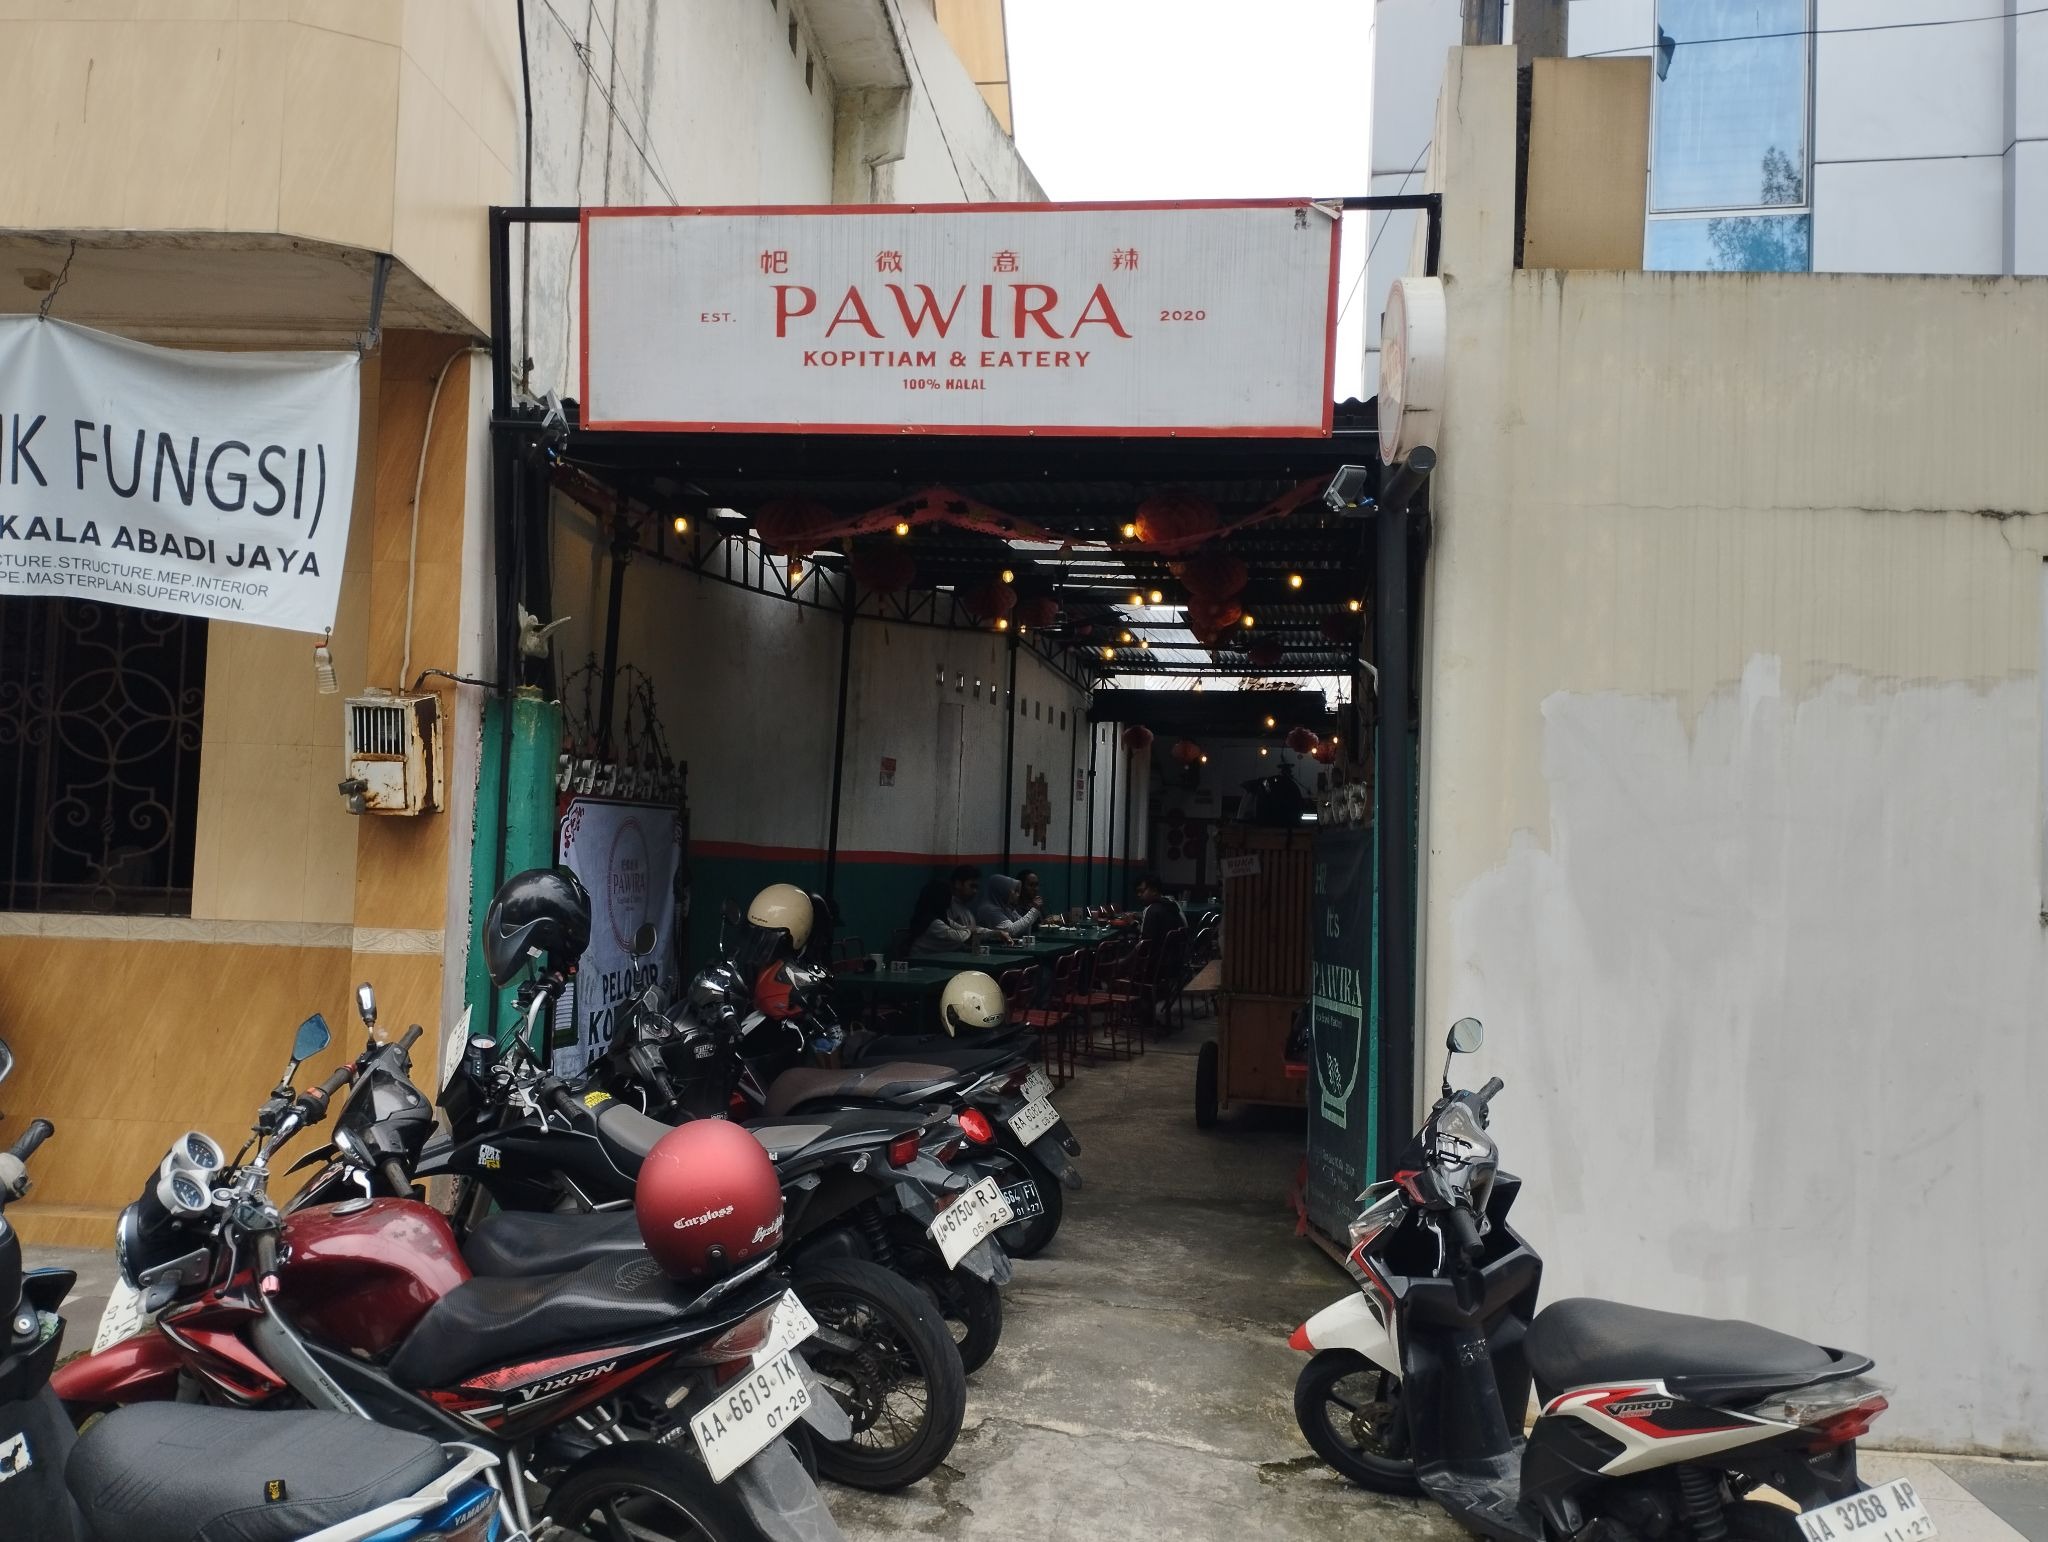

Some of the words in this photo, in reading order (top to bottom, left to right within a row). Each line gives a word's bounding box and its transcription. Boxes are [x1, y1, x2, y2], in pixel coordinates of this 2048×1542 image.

[700, 312, 737, 323] EST.
[769, 283, 1133, 340] PAWIRA
[1159, 310, 1206, 322] 2020
[803, 350, 936, 368] KOPITIAM
[949, 350, 967, 368] &
[980, 351, 1090, 368] EATERY
[903, 378, 941, 390] 100%
[945, 378, 986, 390] HALAL
[74, 418, 326, 540] FUNGSI)
[111, 525, 216, 565] ABADI
[225, 542, 320, 578] JAYA
[602, 963, 660, 1005] PELOOR
[673, 1205, 734, 1230] Cargloss
[947, 1200, 972, 1233] 6750
[974, 1183, 998, 1207] RJ
[699, 1411, 728, 1449] AA
[728, 1374, 772, 1423] 6619
[771, 1353, 797, 1386] TK
[453, 1495, 492, 1528] YAMAHA
[1804, 1514, 1836, 1542] AA
[1836, 1493, 1888, 1532] 3268
[1890, 1481, 1917, 1513] AP
